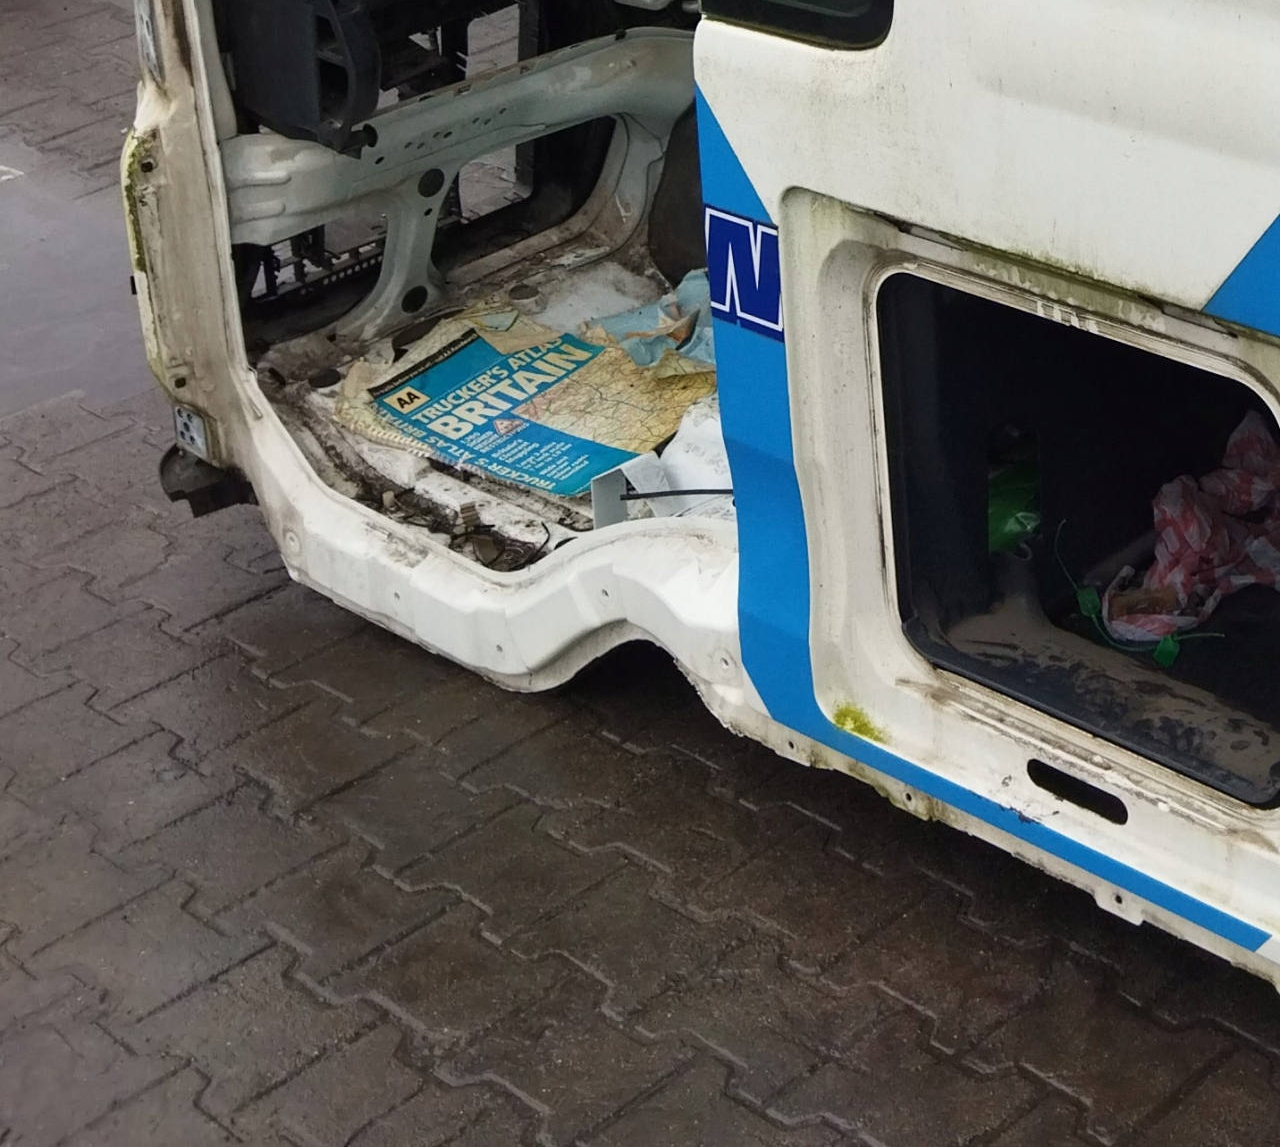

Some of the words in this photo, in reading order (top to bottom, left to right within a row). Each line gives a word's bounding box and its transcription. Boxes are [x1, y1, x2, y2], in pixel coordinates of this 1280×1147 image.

[397, 392, 420, 409] AA
[411, 366, 508, 424] TRUCKER'S
[426, 344, 593, 441] BRITAIN
[369, 402, 427, 438] BRITA
[426, 436, 477, 462] ATLAS
[475, 457, 556, 490] TRUCKER'S
